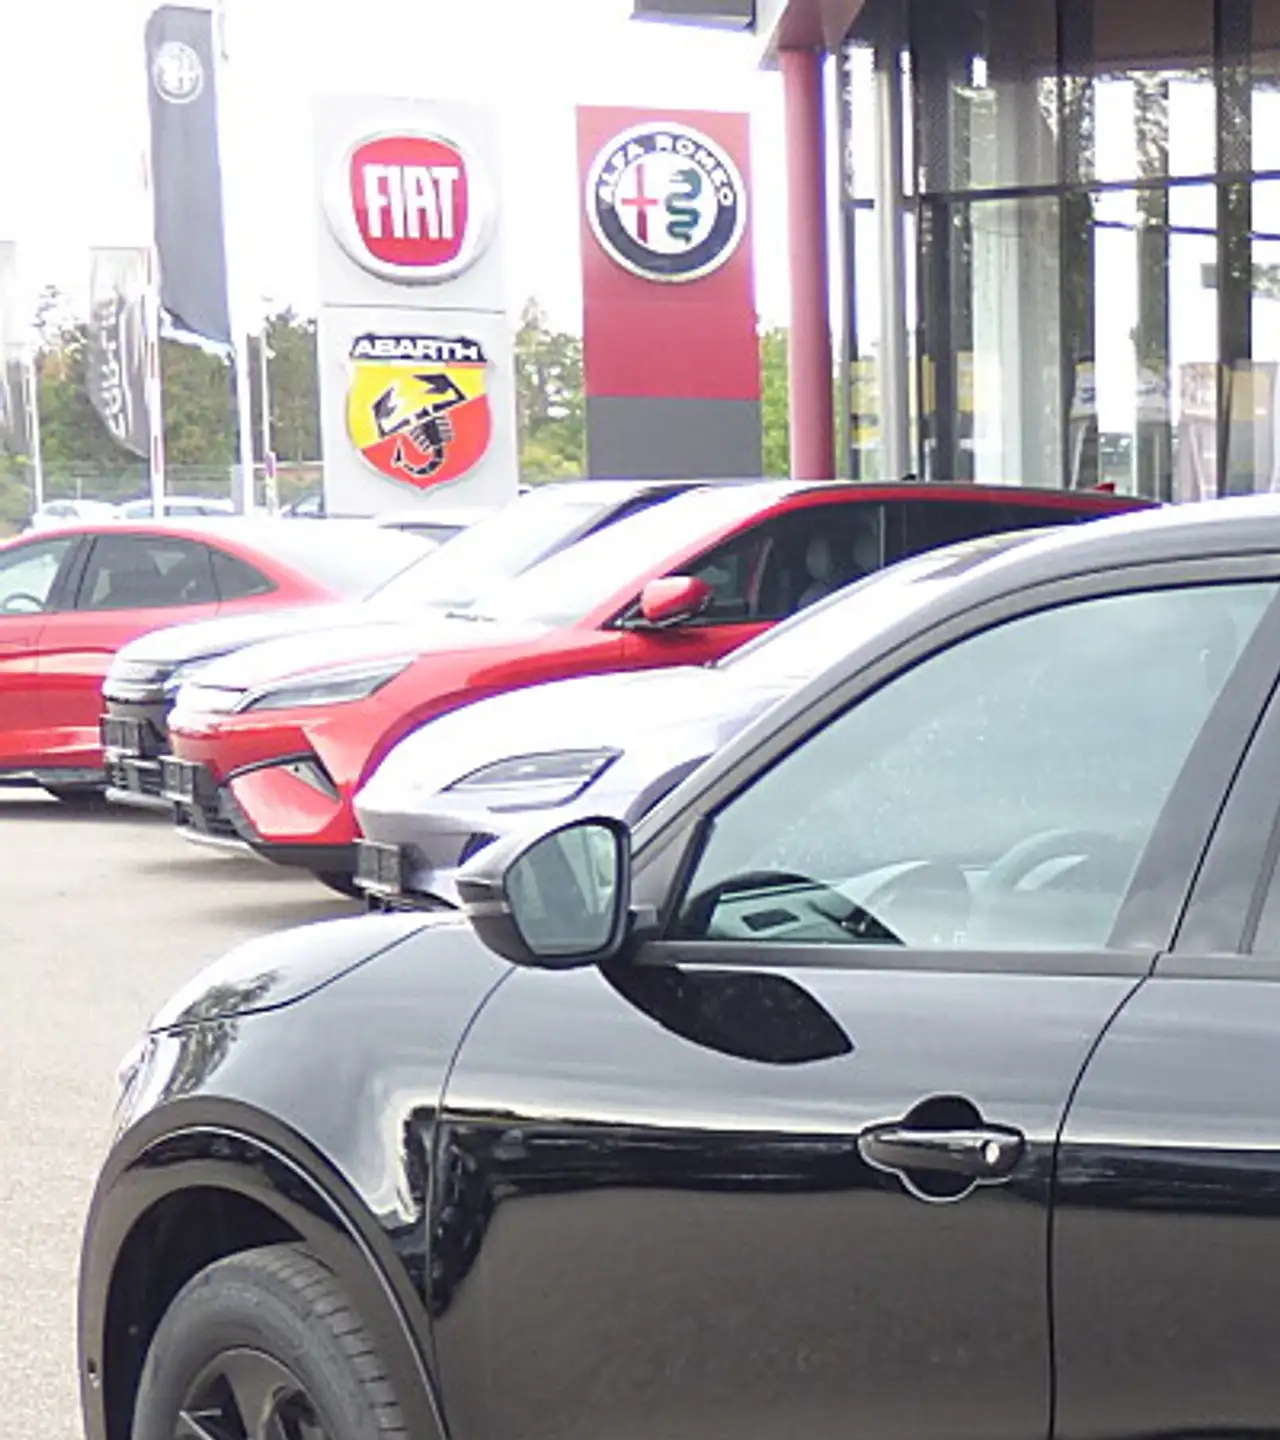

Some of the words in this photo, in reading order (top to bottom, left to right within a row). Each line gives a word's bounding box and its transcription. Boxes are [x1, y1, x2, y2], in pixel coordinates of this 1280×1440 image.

[363, 165, 459, 239] FIAT
[599, 142, 645, 203] ALFA
[655, 134, 734, 207] ROMEO
[354, 338, 480, 361] ABARTH
